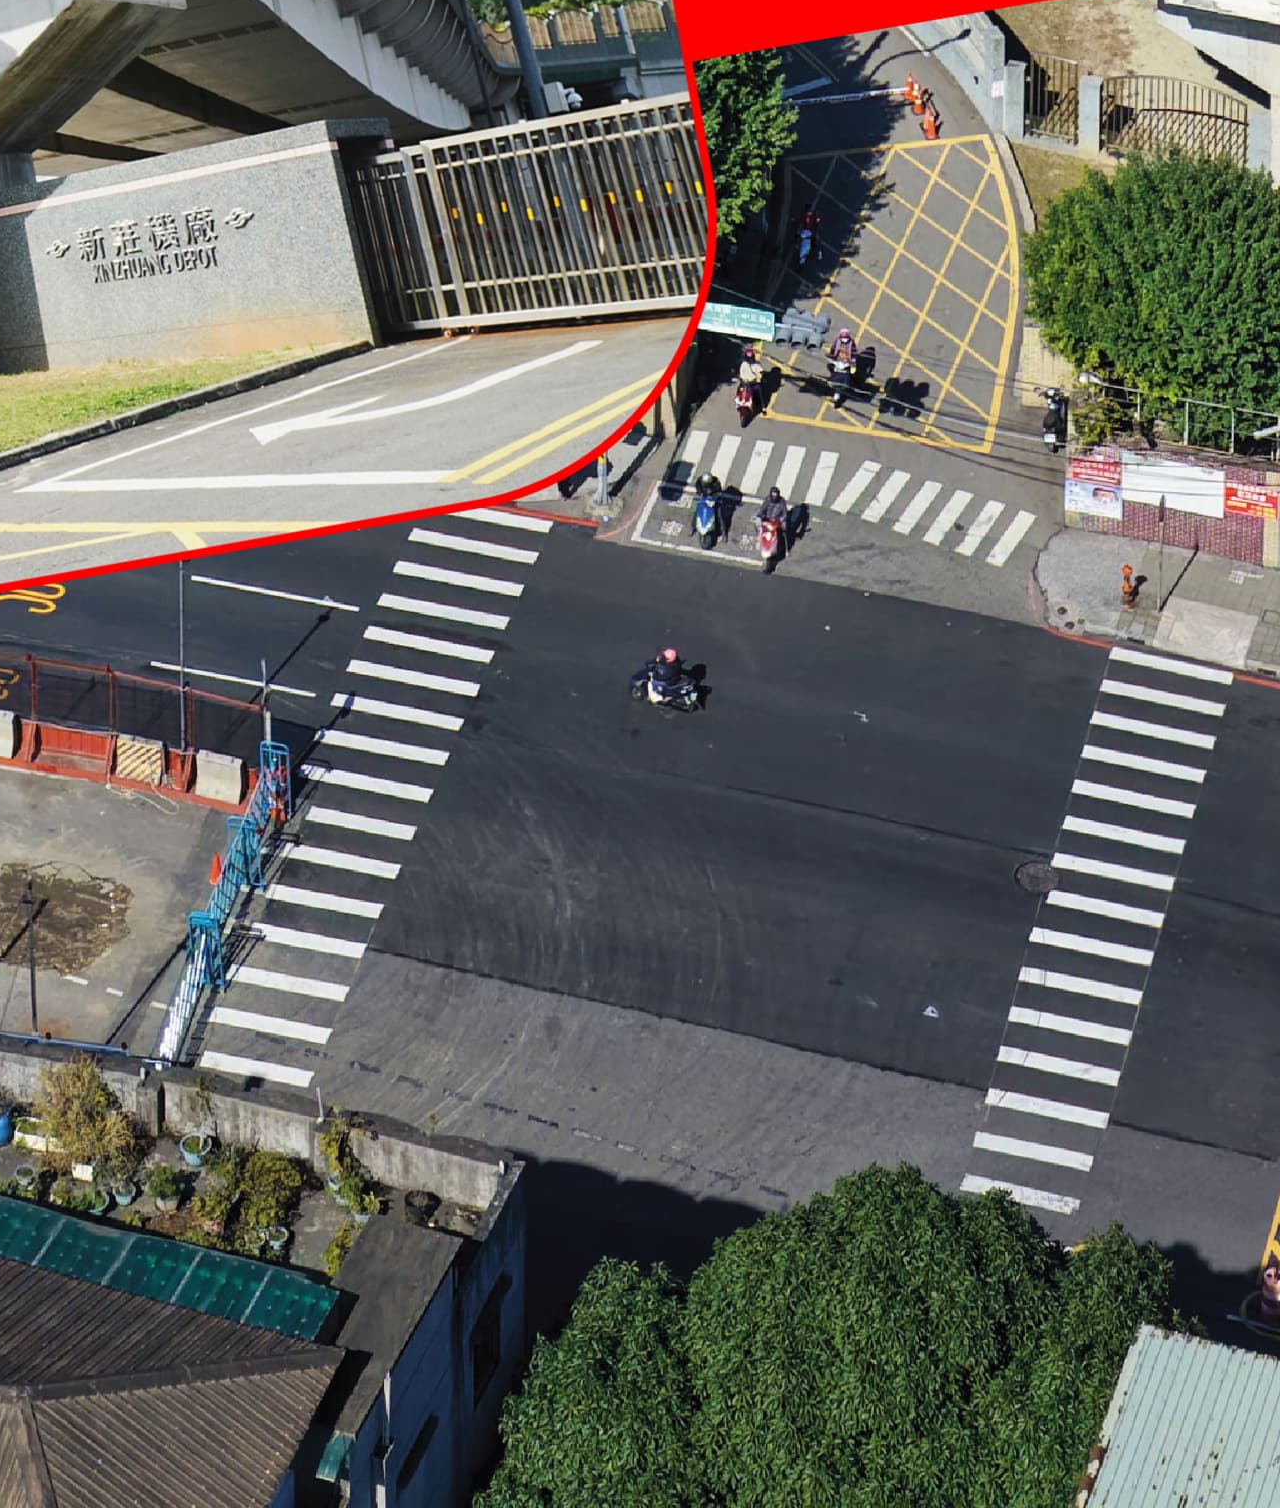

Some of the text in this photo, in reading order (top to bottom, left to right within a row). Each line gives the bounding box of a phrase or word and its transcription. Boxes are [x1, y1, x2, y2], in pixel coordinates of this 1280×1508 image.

[74, 206, 219, 262] 新莊機廠
[92, 245, 219, 283] XINZHUANG DEPOT
